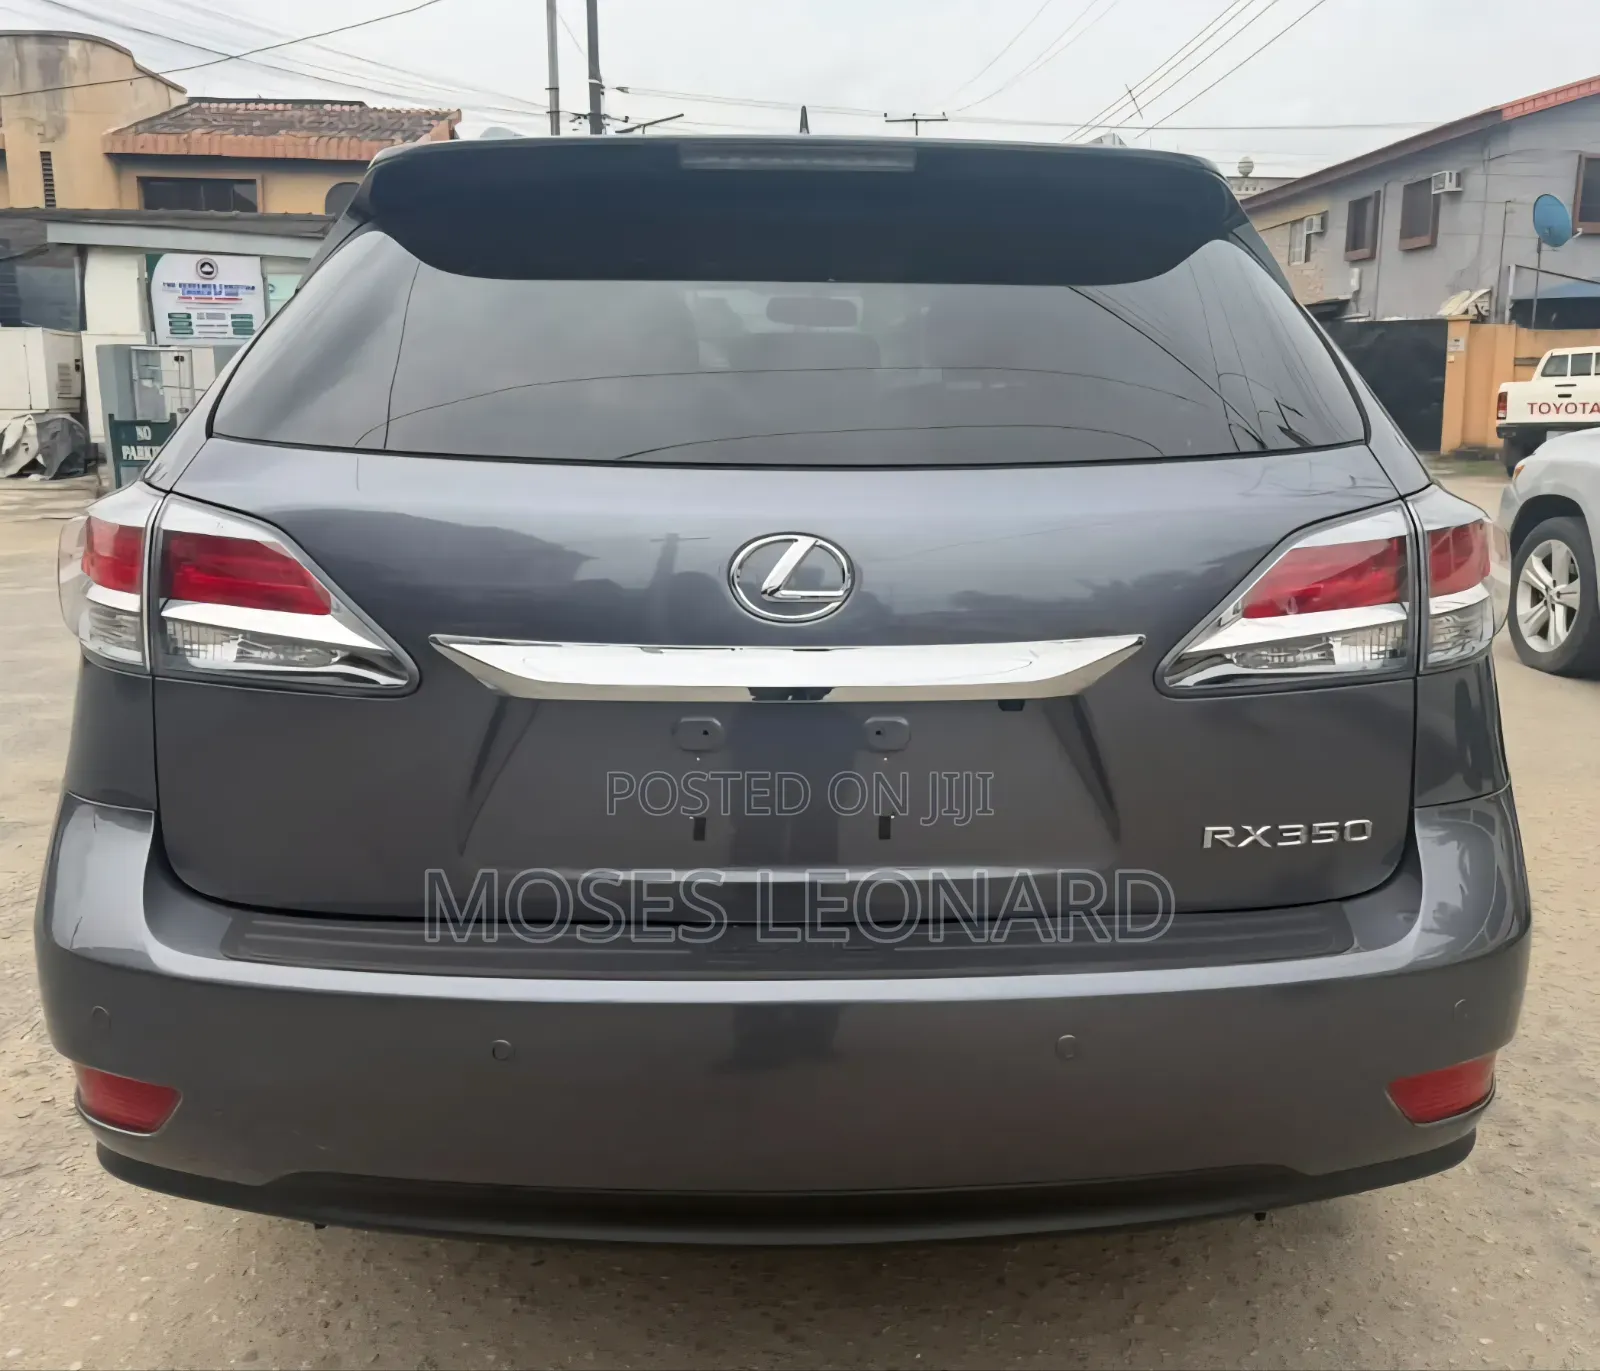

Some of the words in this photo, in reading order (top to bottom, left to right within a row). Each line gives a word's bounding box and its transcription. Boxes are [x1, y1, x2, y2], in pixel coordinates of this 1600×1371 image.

[1527, 402, 1600, 415] TOYOTA
[136, 425, 152, 441] NO
[1203, 819, 1373, 848] RX350
